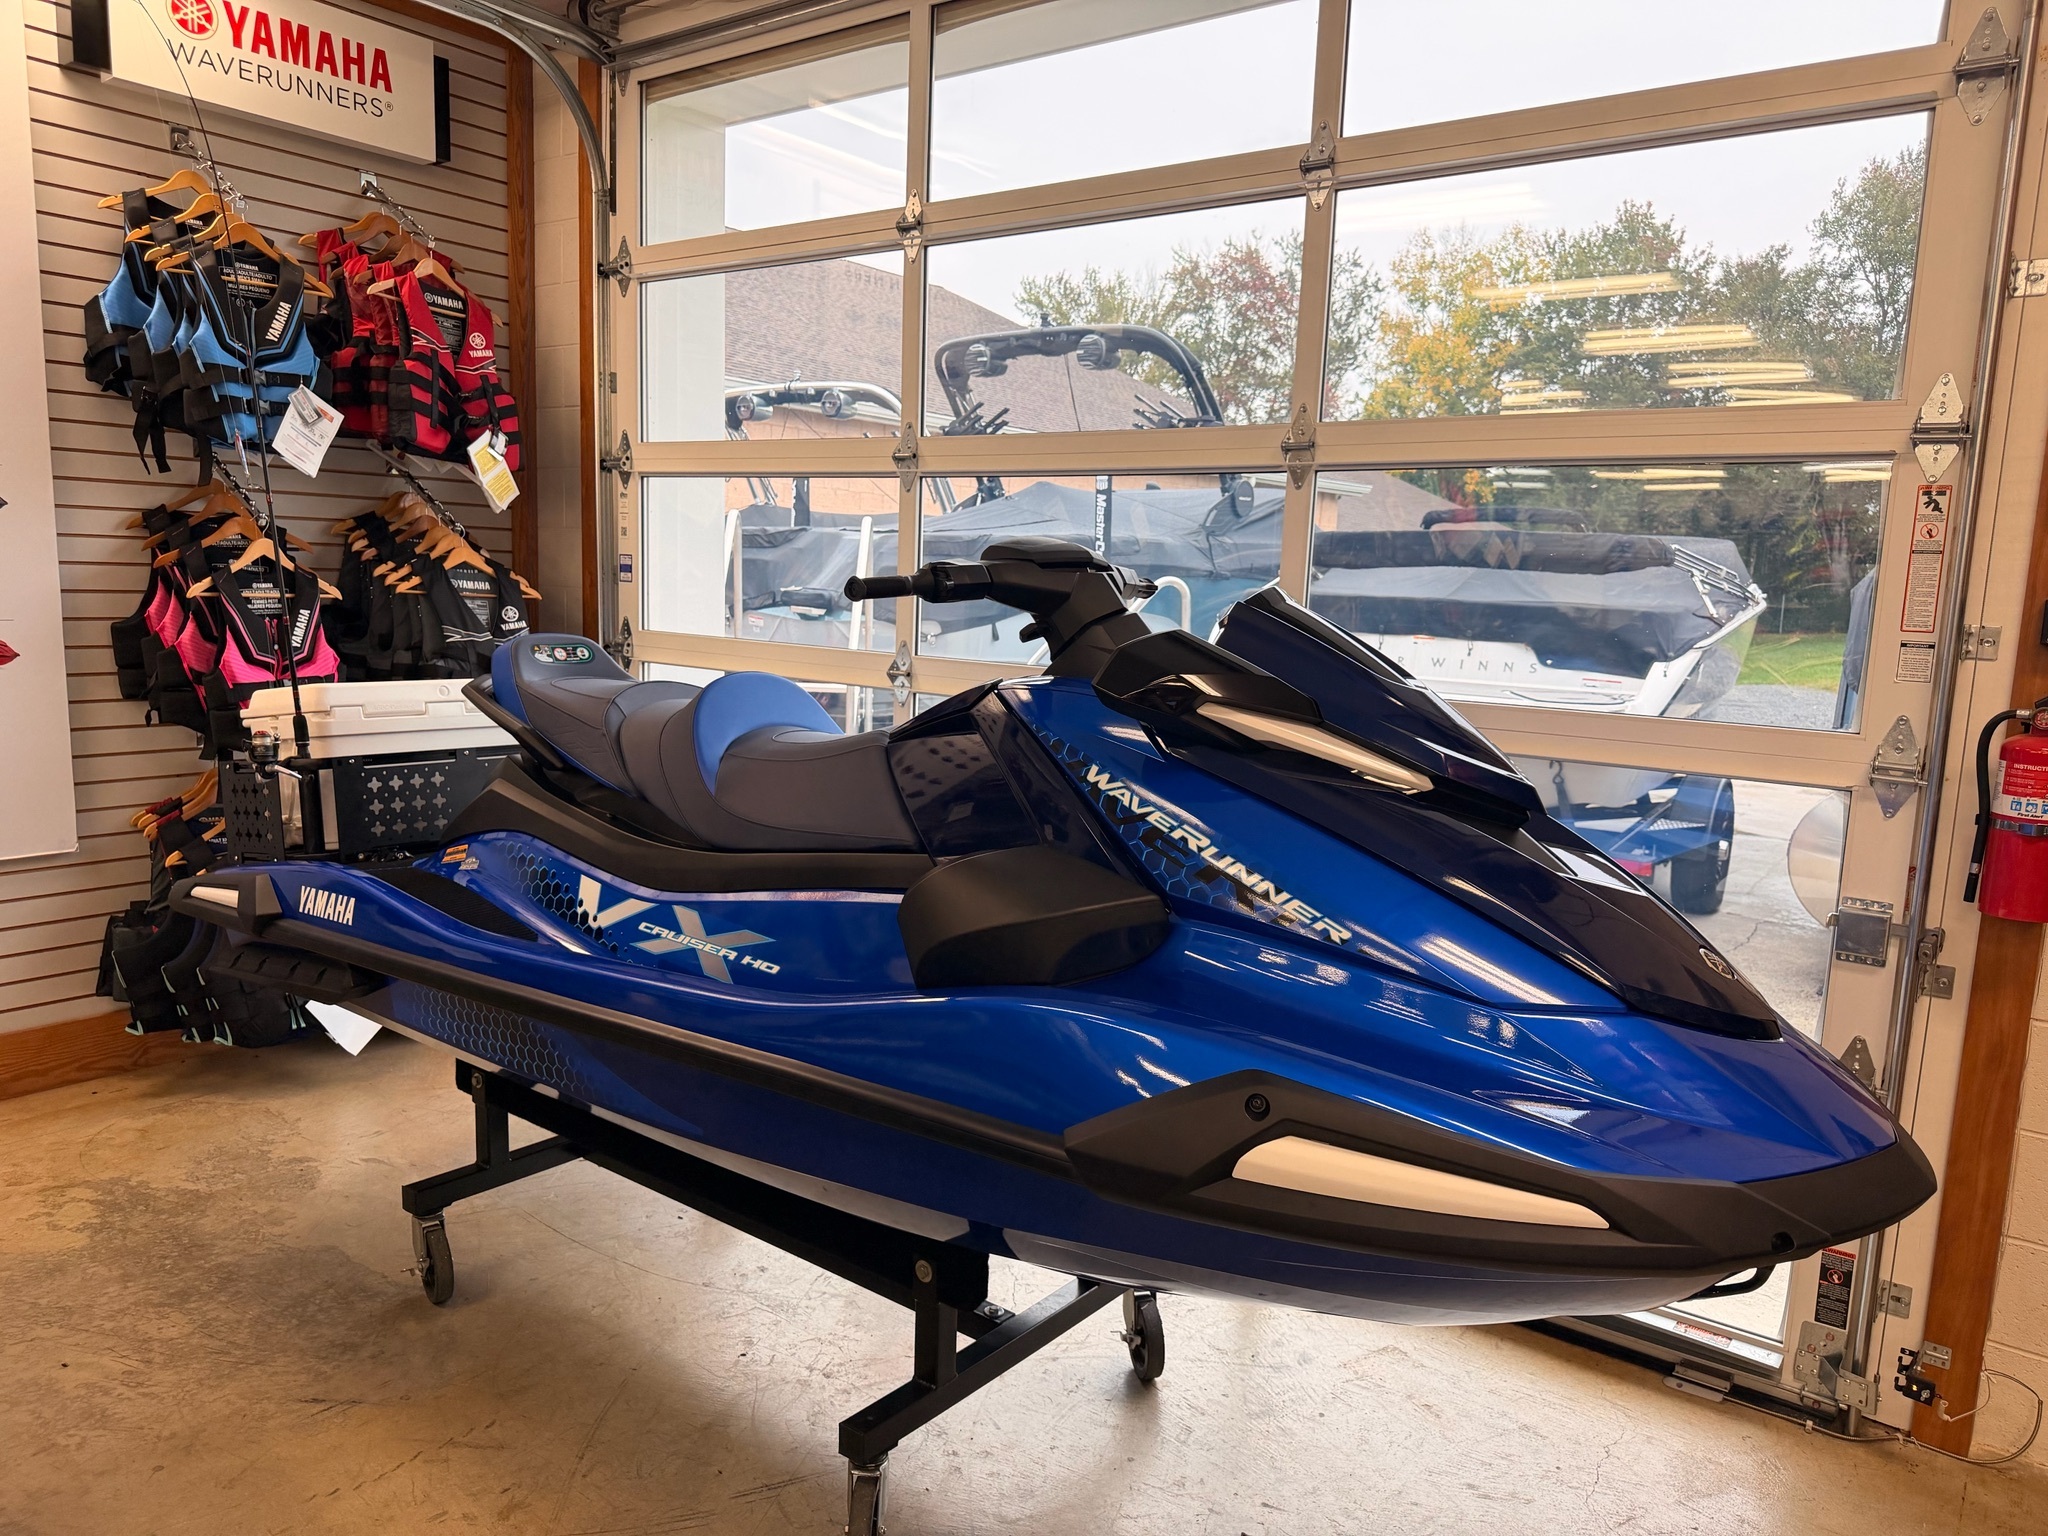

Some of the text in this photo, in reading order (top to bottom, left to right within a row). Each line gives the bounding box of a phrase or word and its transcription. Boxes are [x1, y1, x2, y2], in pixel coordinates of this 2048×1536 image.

[222, 0, 393, 94] YAMAHA
[265, 301, 292, 342] YAMAHA
[433, 294, 464, 310] YAMAHA
[468, 349, 494, 358] YAMAHA
[457, 579, 490, 591] YAMAHA
[291, 608, 311, 648] YAMAHA
[501, 620, 528, 631] YAMAHA
[1431, 657, 1537, 674] WINNS
[1085, 763, 1353, 946] WAVERUNNER
[299, 885, 356, 926] YAMAHA
[637, 921, 781, 975] CRUISER HO
